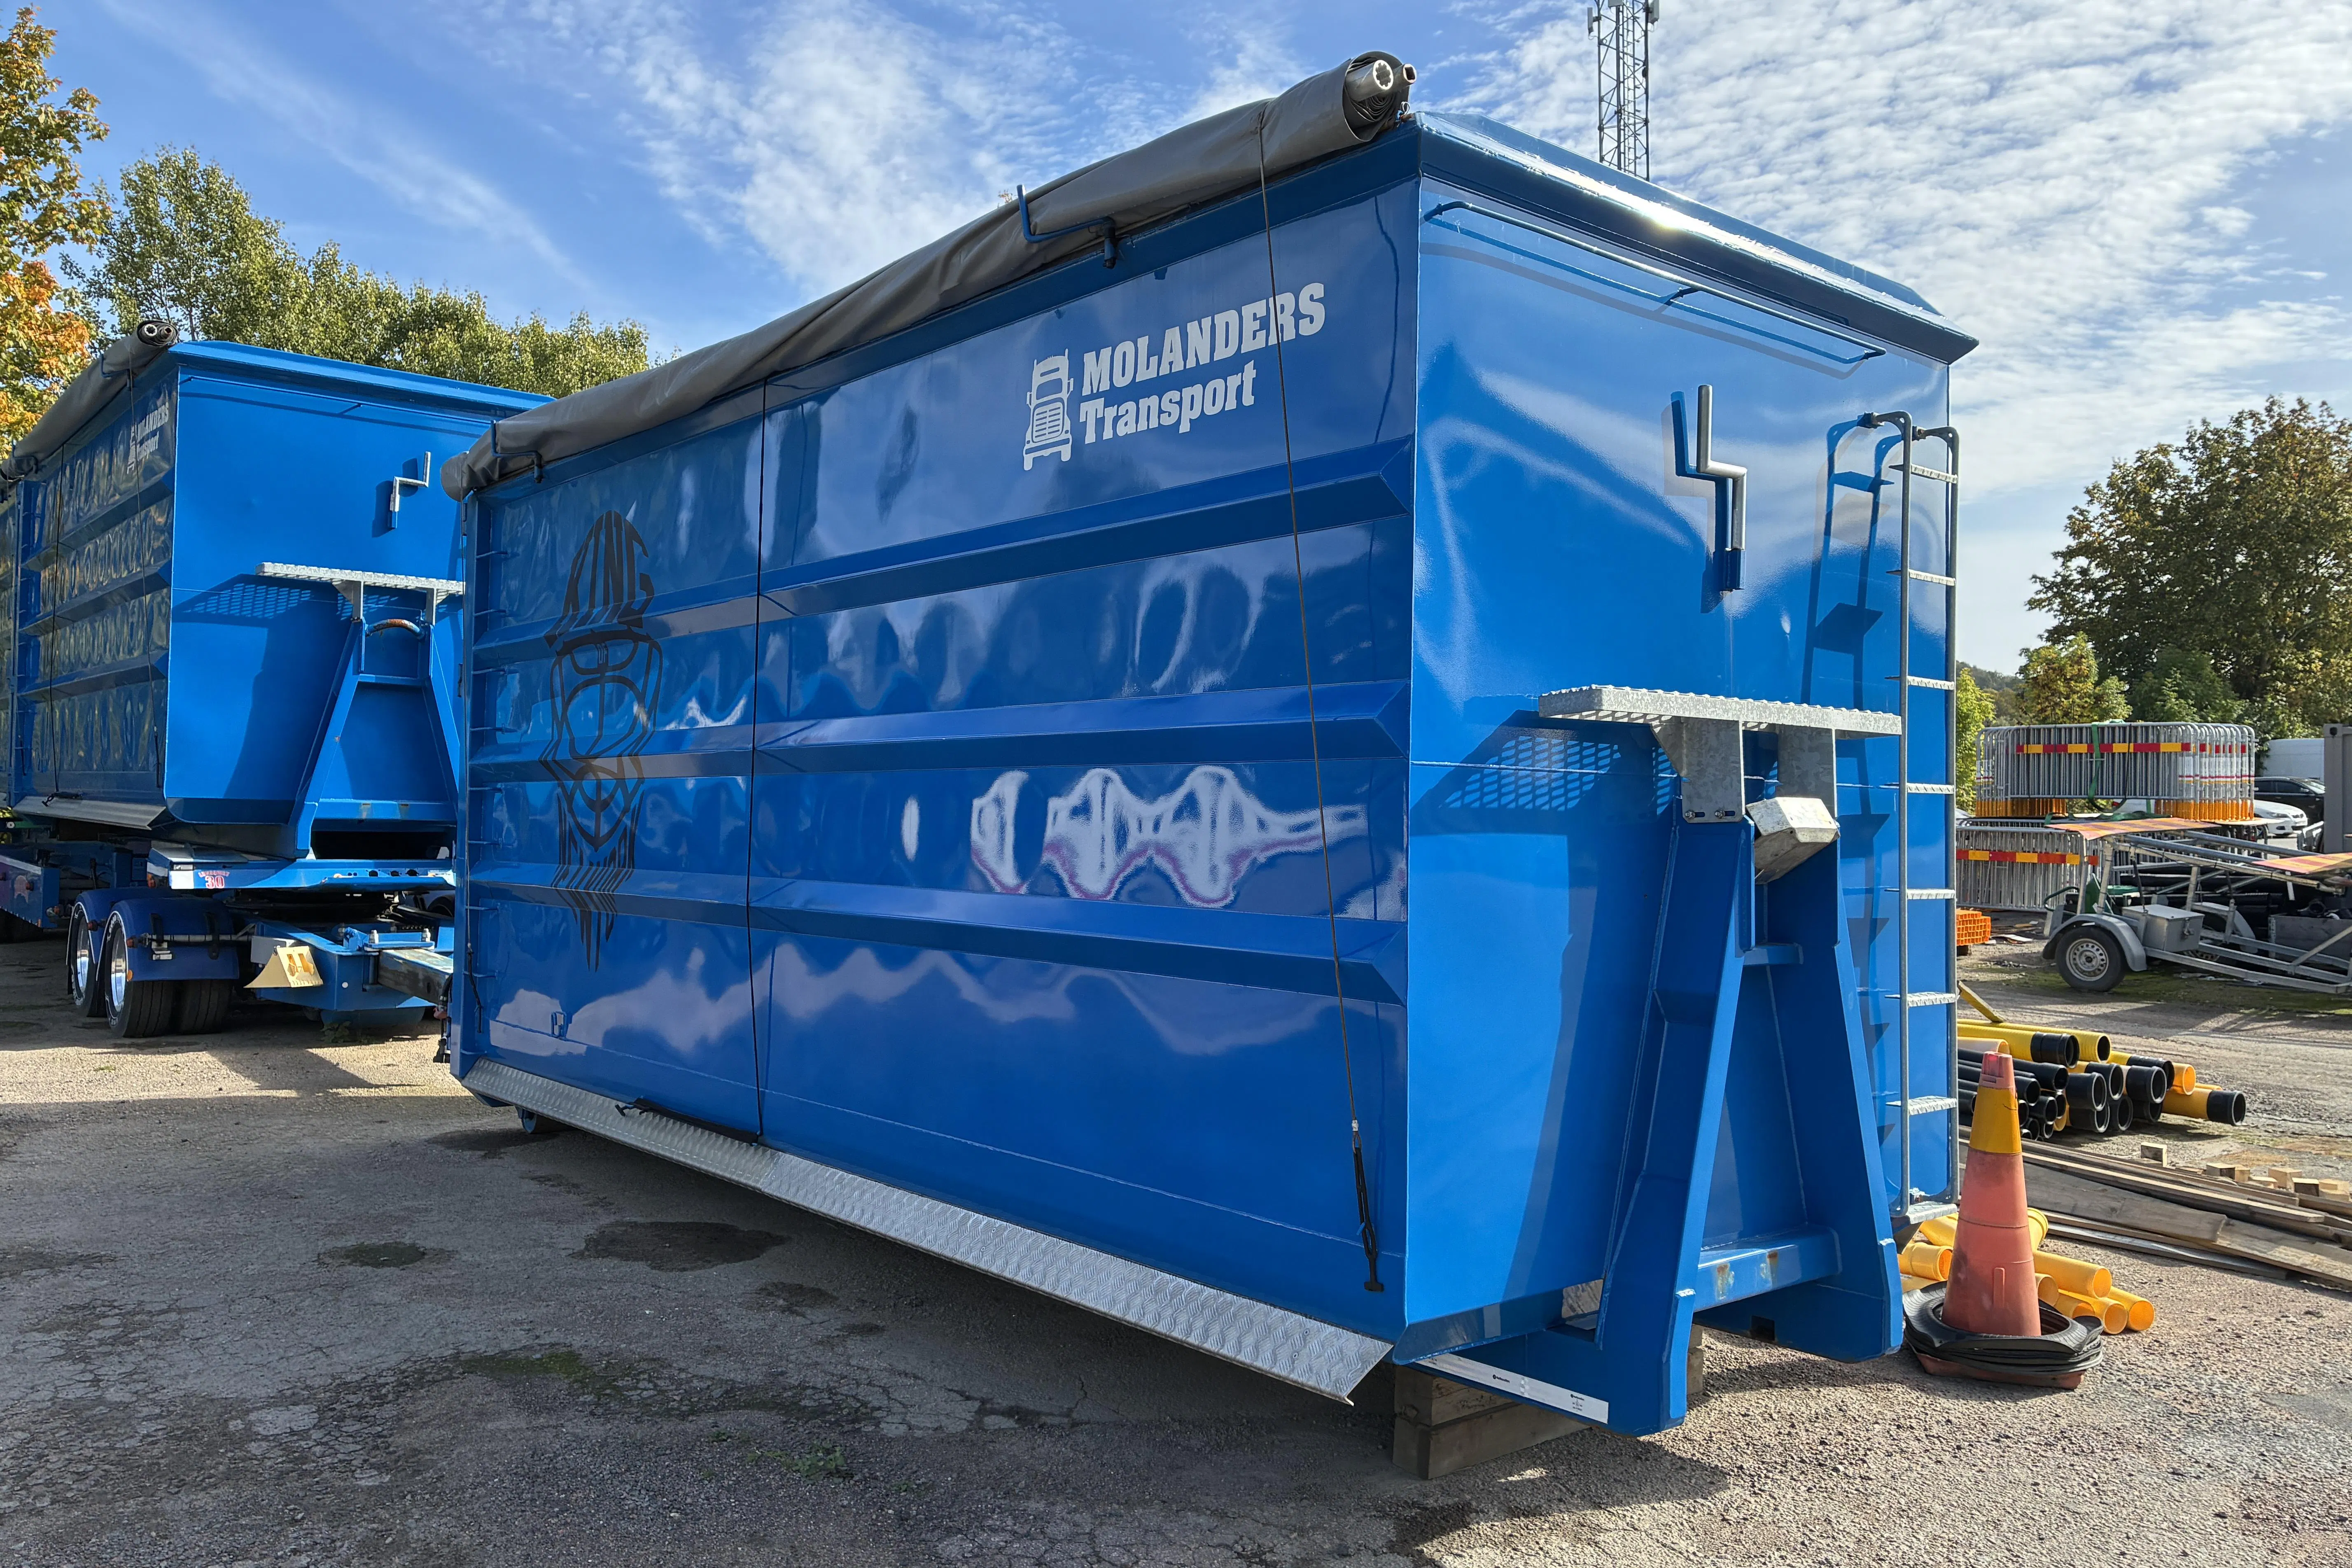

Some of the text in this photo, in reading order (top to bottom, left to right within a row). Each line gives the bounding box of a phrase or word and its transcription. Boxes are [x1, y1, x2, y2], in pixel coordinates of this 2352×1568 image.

[1081, 282, 1325, 396] MOLANDERS
[1080, 359, 1256, 444] Transport
[205, 875, 225, 889] 30
